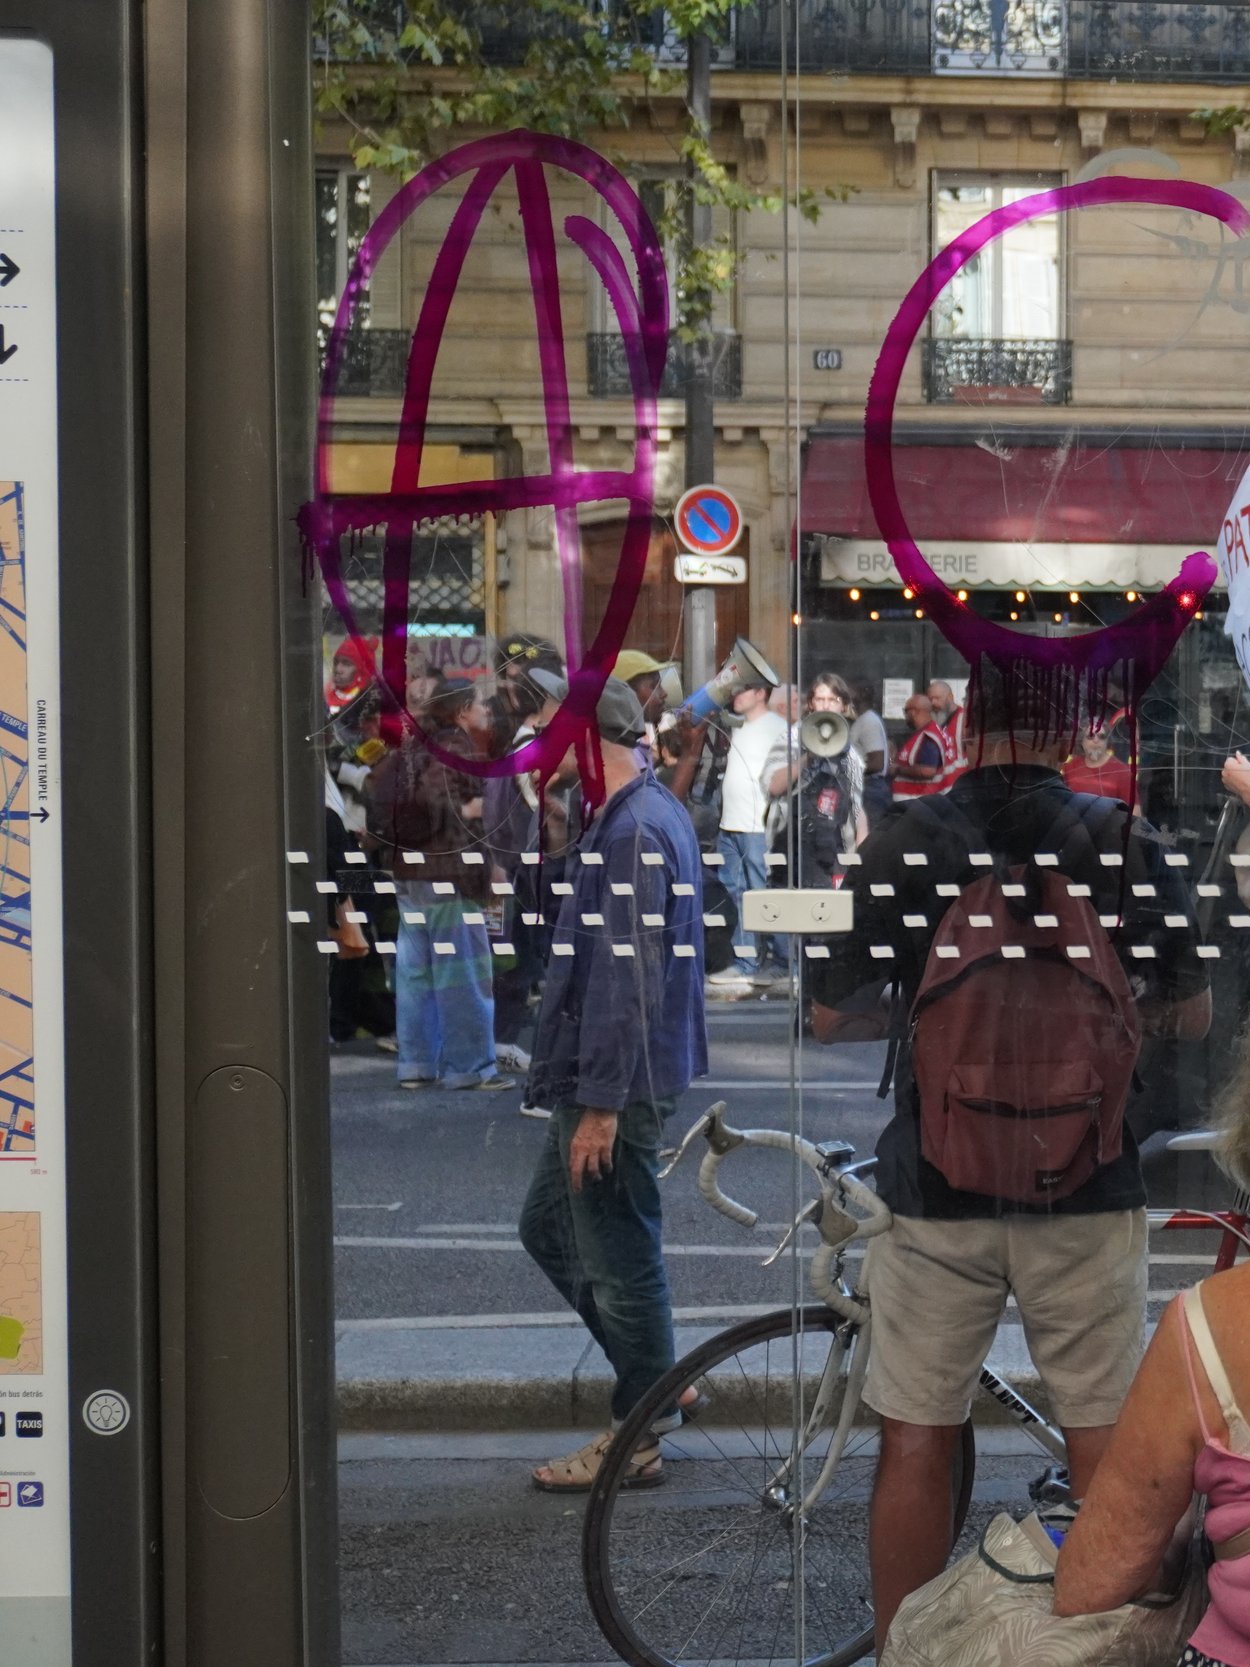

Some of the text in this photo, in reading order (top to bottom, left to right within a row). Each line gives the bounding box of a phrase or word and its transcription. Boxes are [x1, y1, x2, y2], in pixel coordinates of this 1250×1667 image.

[817, 351, 838, 369] 60
[857, 554, 977, 573] BRAERIE
[2, 713, 27, 732] TEMPLE
[36, 699, 48, 801] CARREAU DU TEMPLE
[16, 1419, 42, 1429] TAXIS
